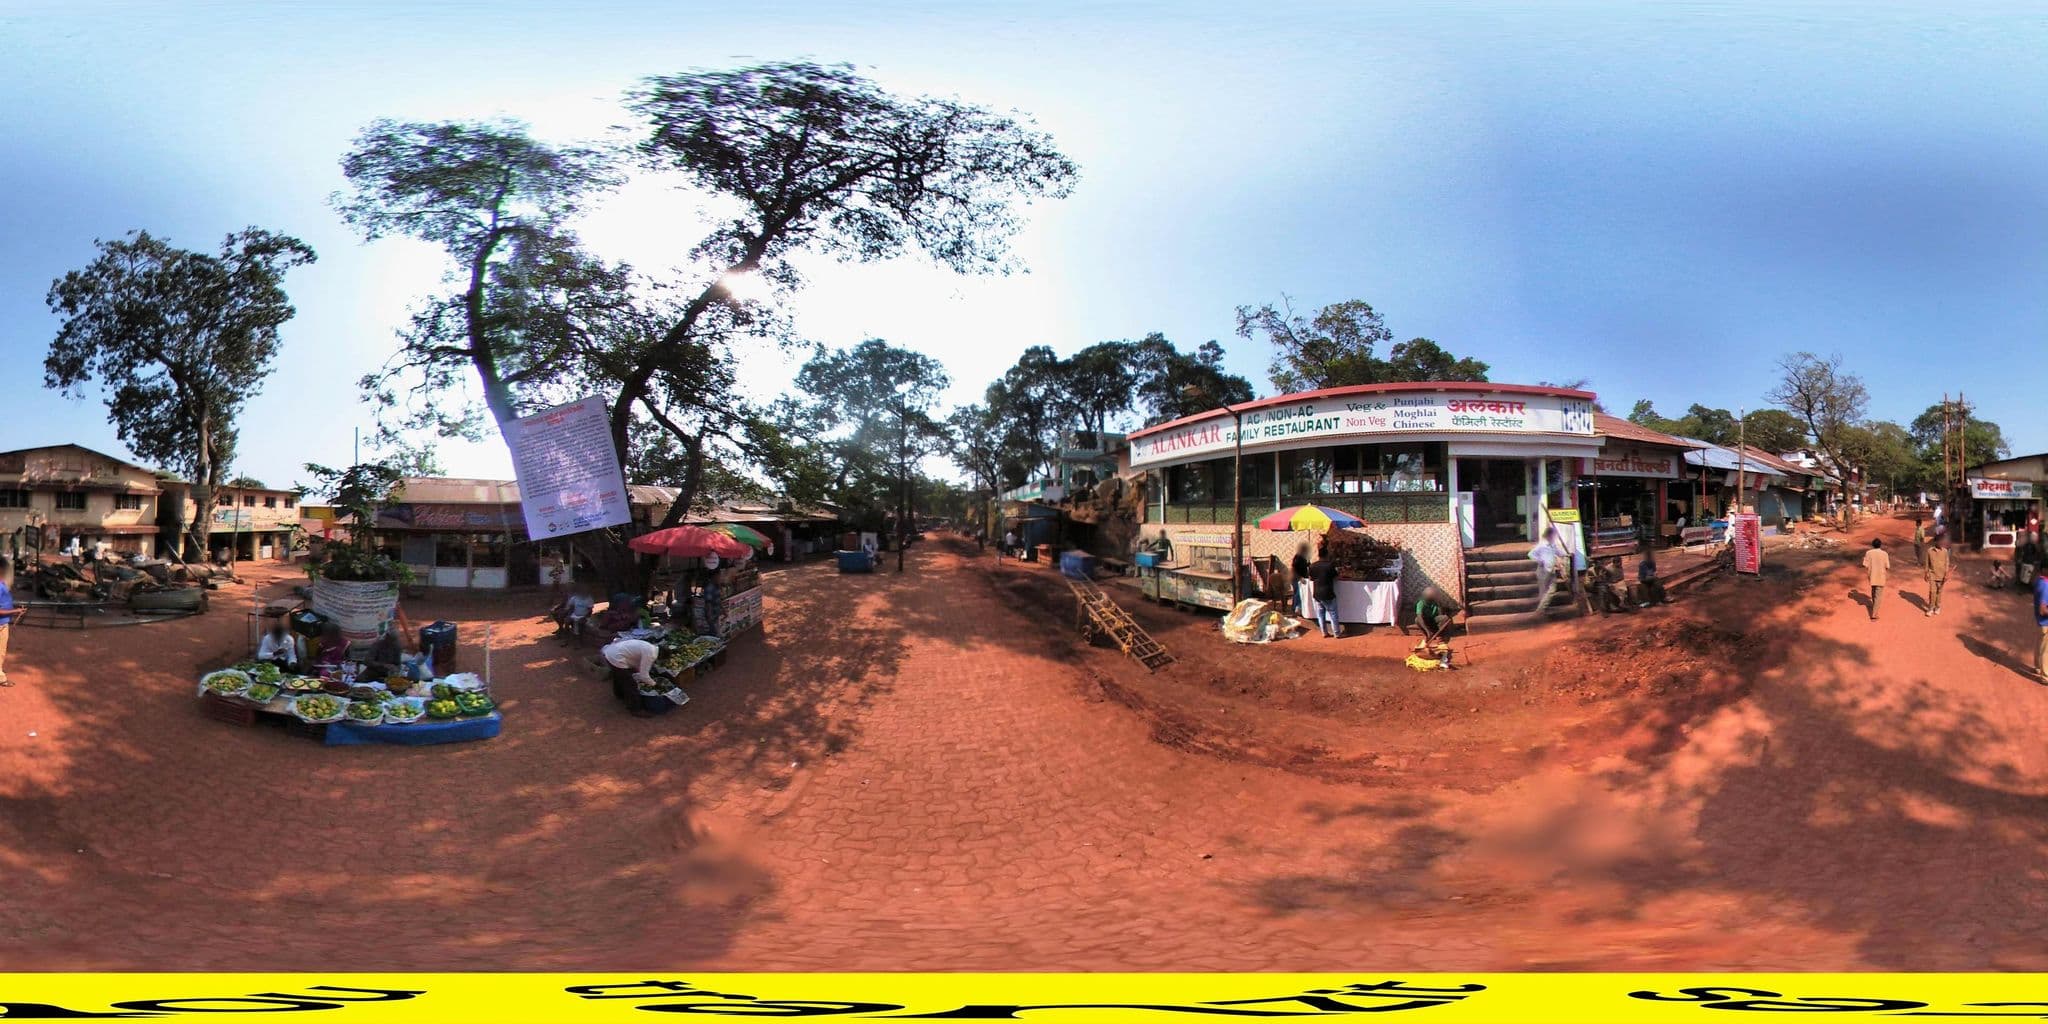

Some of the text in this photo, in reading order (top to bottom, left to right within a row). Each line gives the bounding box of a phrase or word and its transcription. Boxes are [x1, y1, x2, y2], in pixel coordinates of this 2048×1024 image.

[1346, 402, 1386, 413] Veg &
[1394, 397, 1434, 407] Punjabi
[1447, 393, 1526, 415] अलंकार
[1393, 409, 1437, 420] Moghlai
[1264, 417, 1340, 437] RESTAURANT
[1346, 416, 1386, 427] Non Veg
[1393, 420, 1435, 429] Chinese
[1151, 423, 1221, 455] ALANKAR
